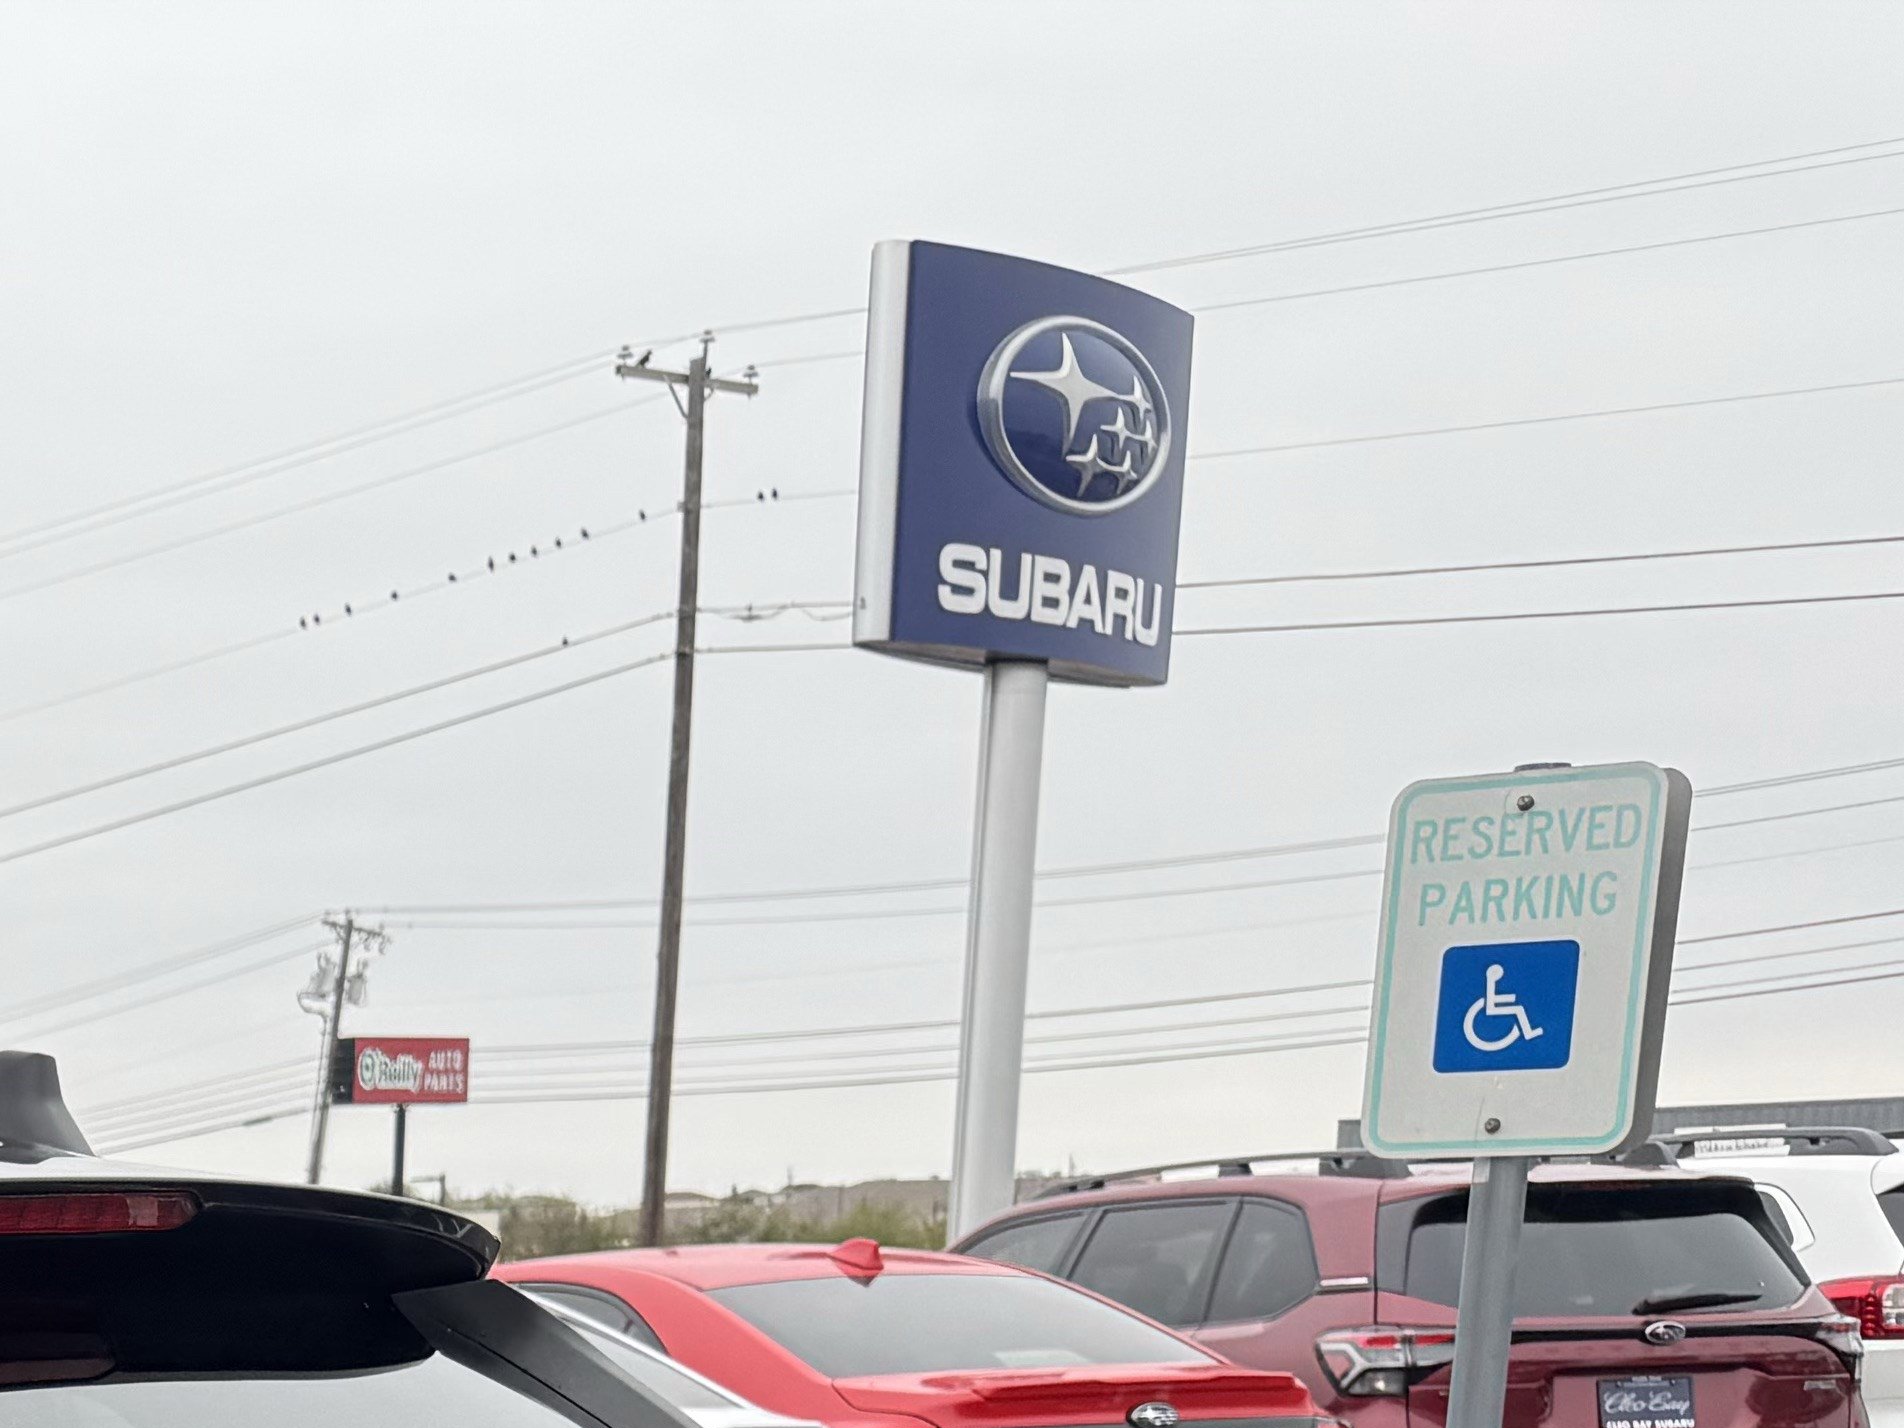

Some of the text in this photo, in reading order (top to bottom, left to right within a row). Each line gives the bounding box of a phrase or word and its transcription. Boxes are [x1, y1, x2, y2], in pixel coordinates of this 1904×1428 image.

[938, 543, 1162, 646] SUBARU
[1410, 803, 1642, 865] RESERVED
[1417, 870, 1619, 927] PARKING
[424, 1072, 464, 1094] PARTS
[428, 1049, 464, 1071] AUTO
